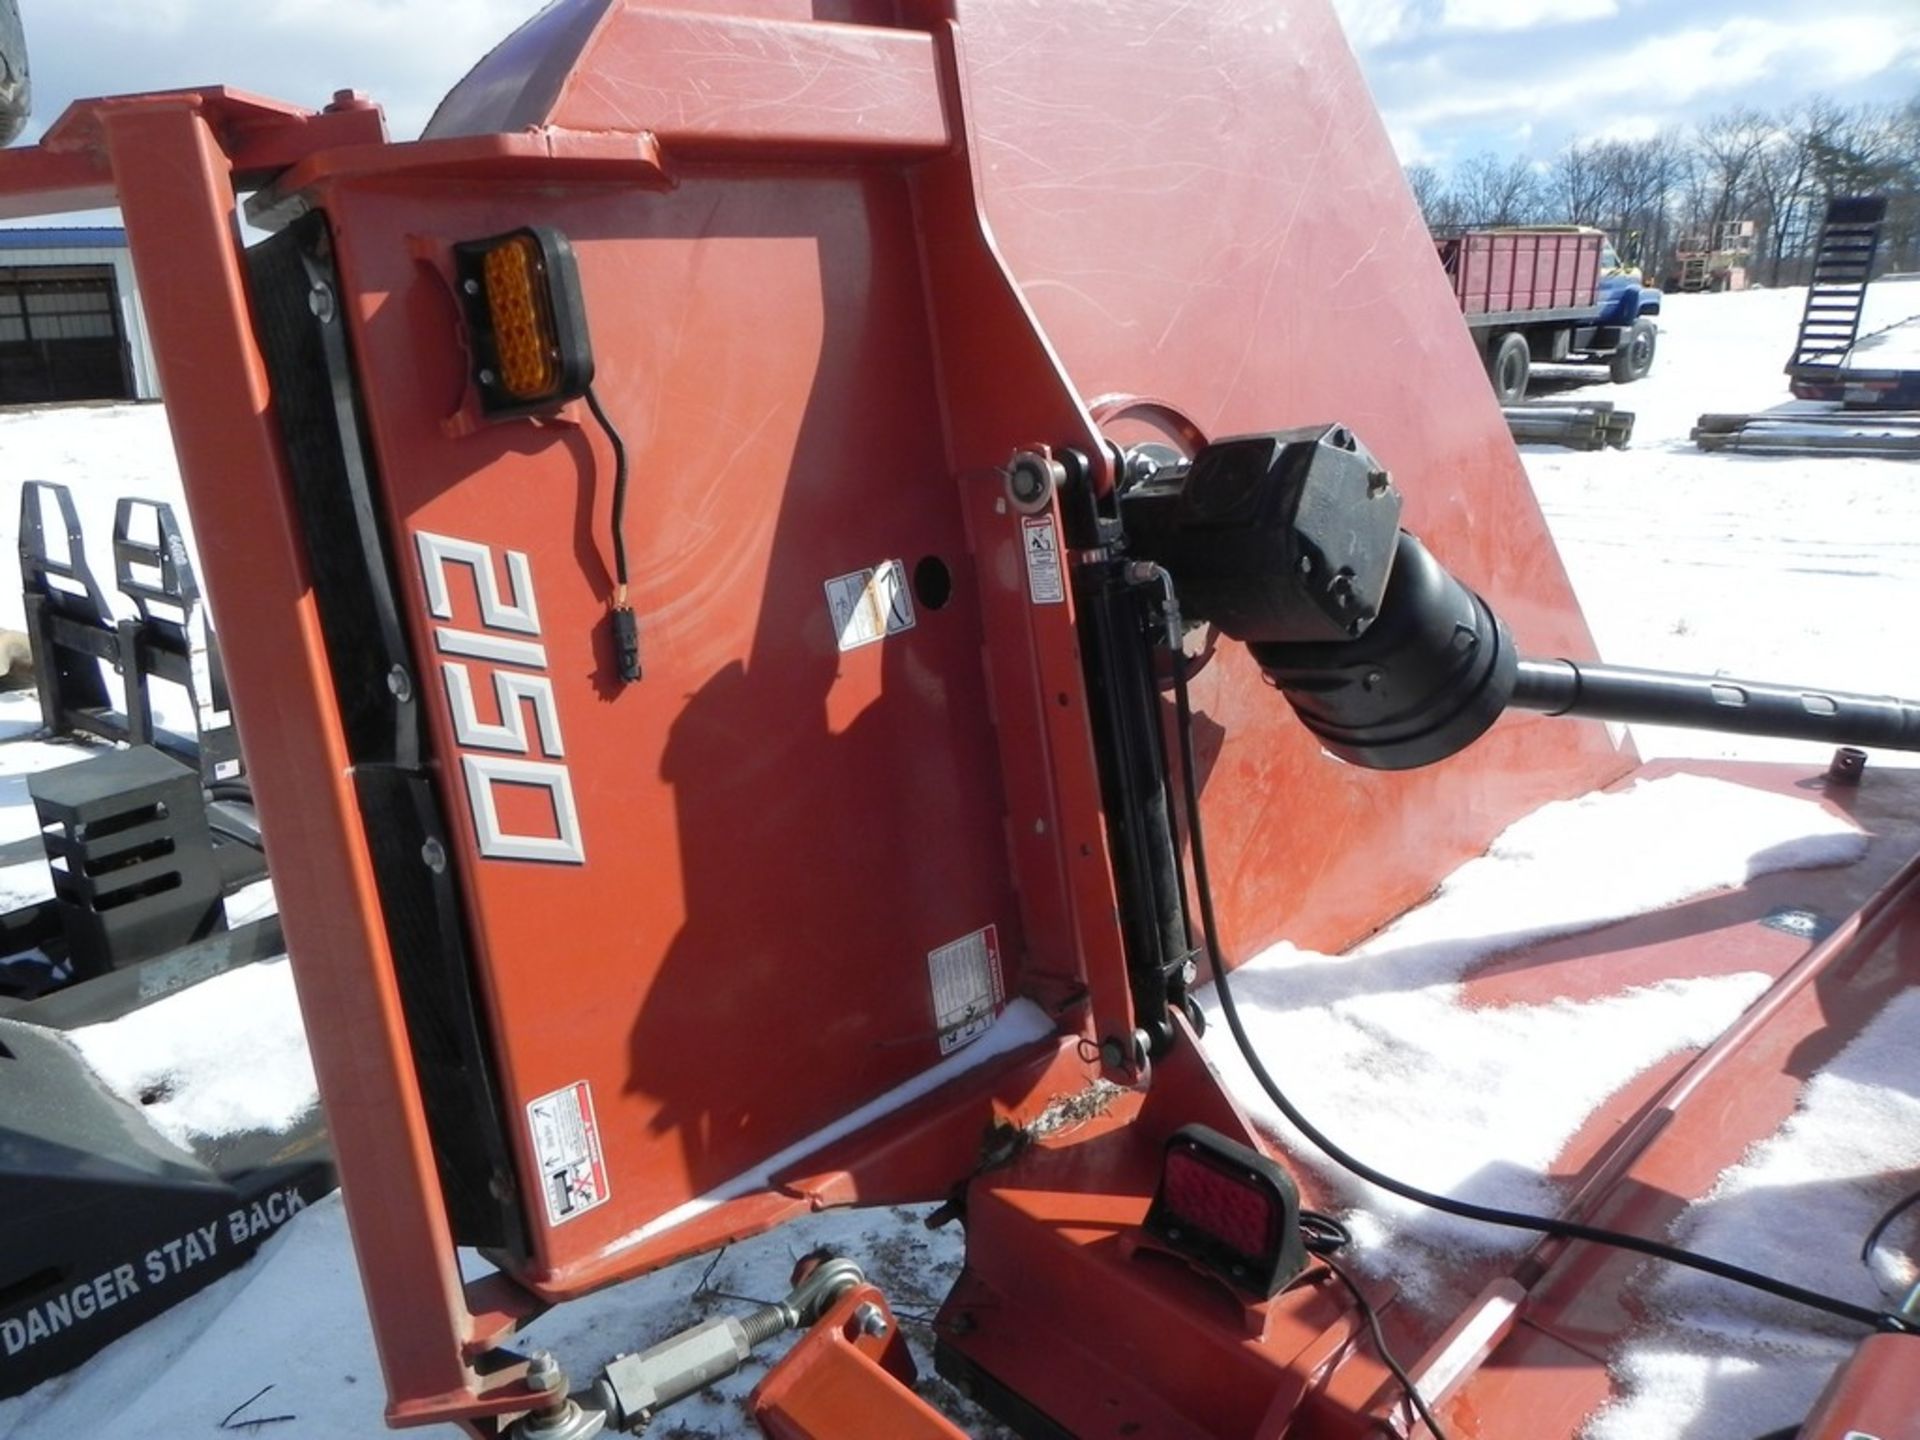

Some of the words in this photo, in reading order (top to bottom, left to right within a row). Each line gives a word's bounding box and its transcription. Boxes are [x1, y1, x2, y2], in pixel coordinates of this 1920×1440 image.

[414, 530, 586, 864] 2150
[0, 1263, 141, 1356] DANGER
[145, 1221, 219, 1284] STAY
[228, 1187, 307, 1245] BACK
